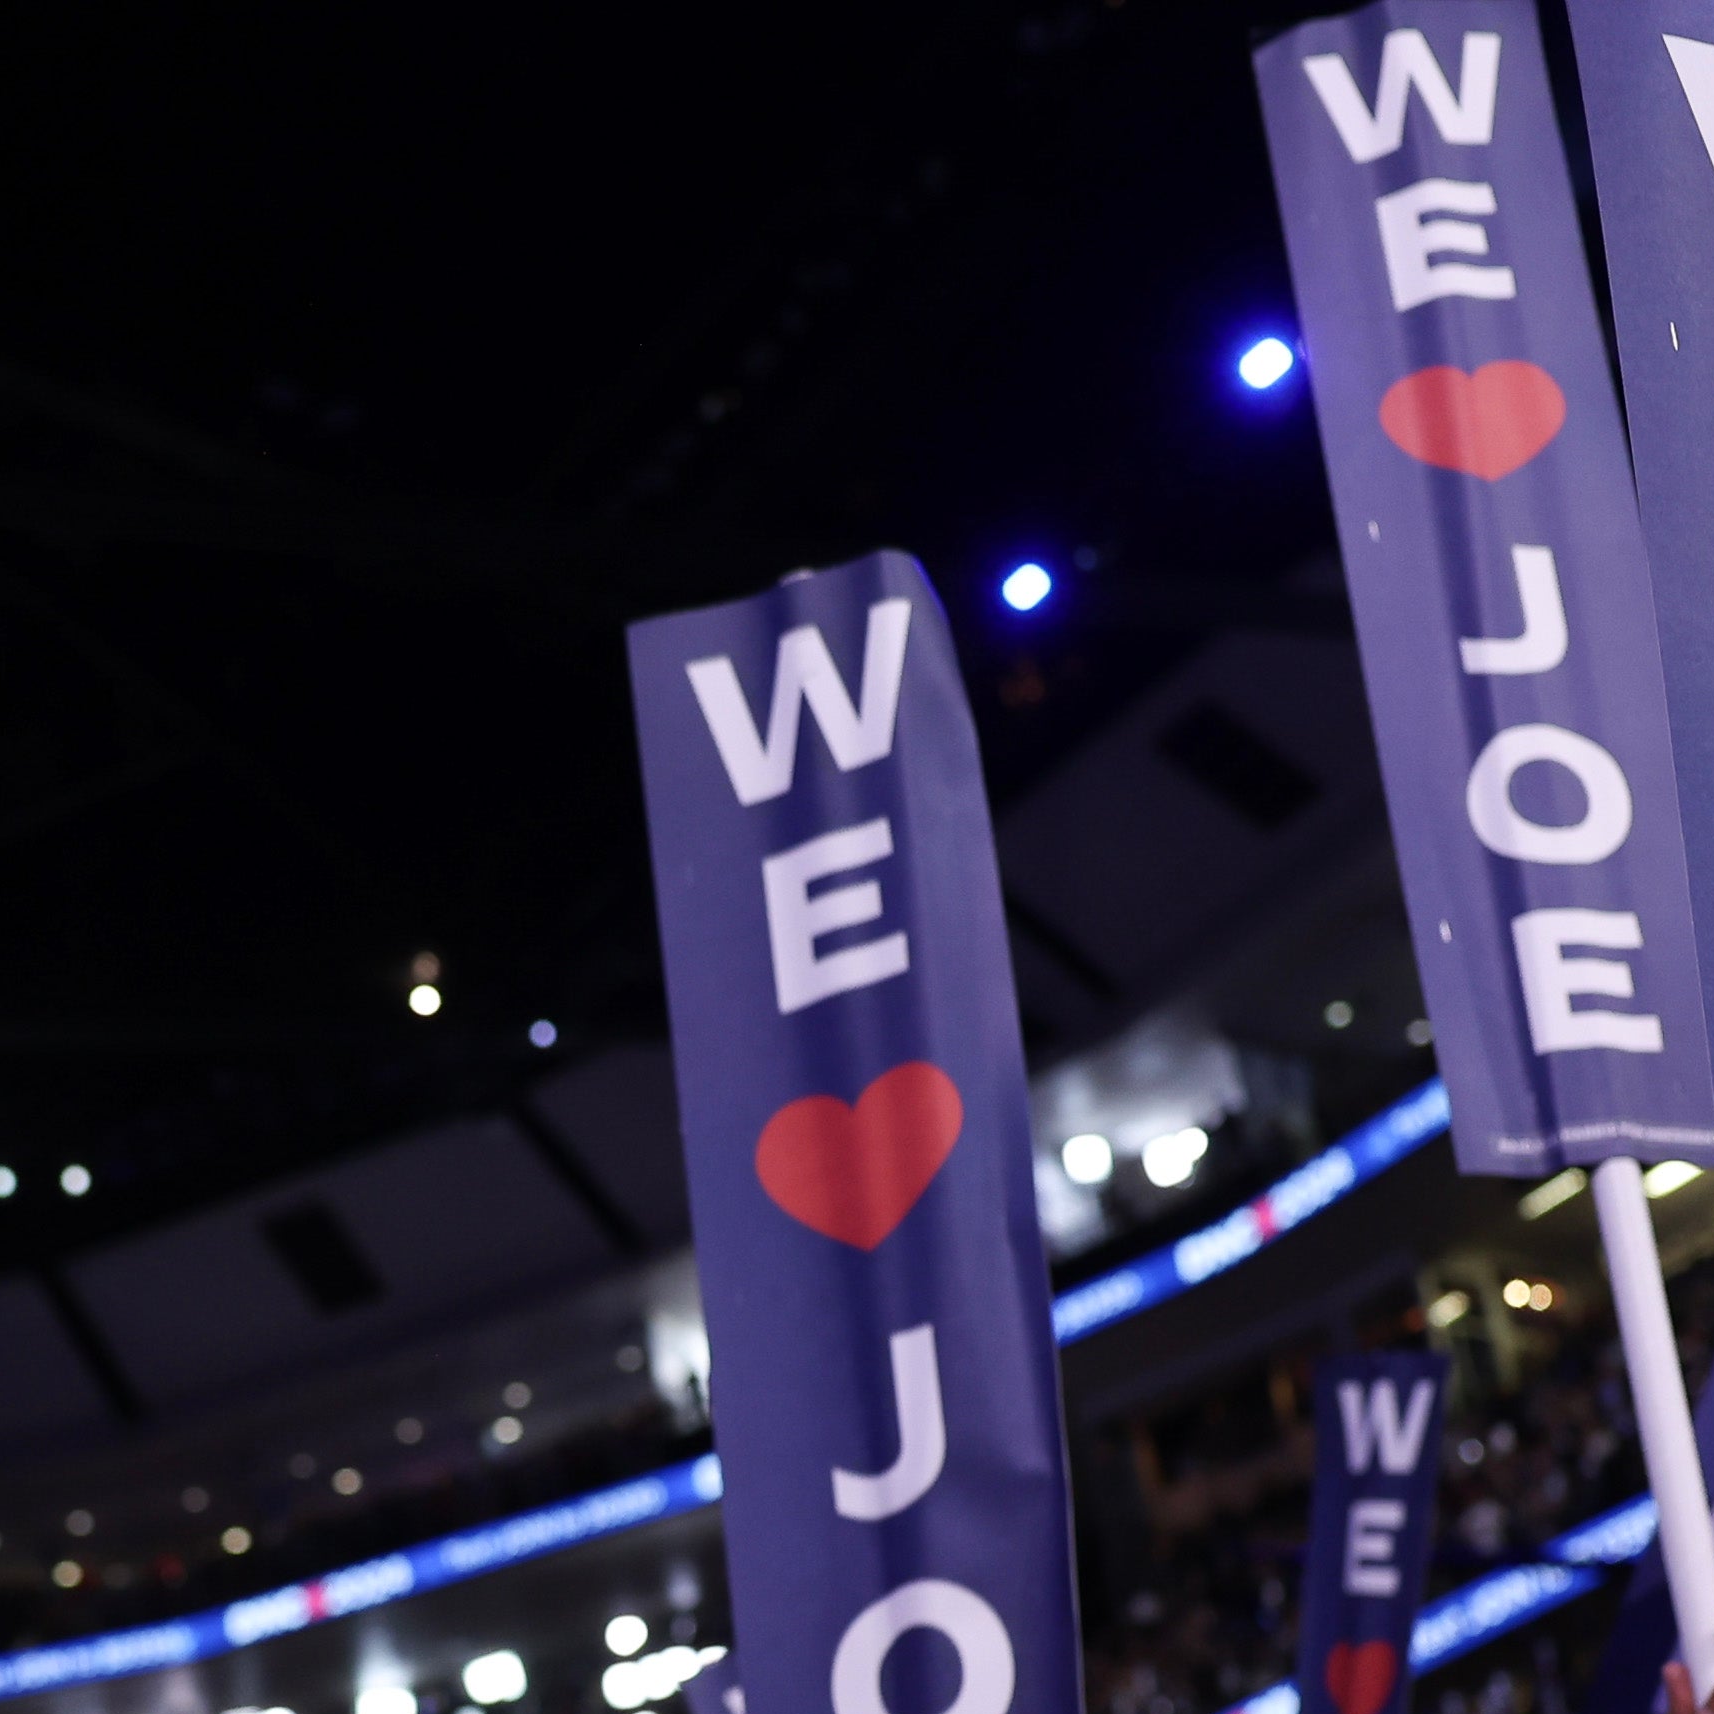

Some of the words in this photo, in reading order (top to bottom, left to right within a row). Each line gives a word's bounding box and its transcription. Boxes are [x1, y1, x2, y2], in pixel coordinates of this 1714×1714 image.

[1303, 28, 1517, 314] WE
[1458, 543, 1665, 1056] JOE
[686, 597, 912, 1016] WE
[1335, 1377, 1437, 1597] WE
